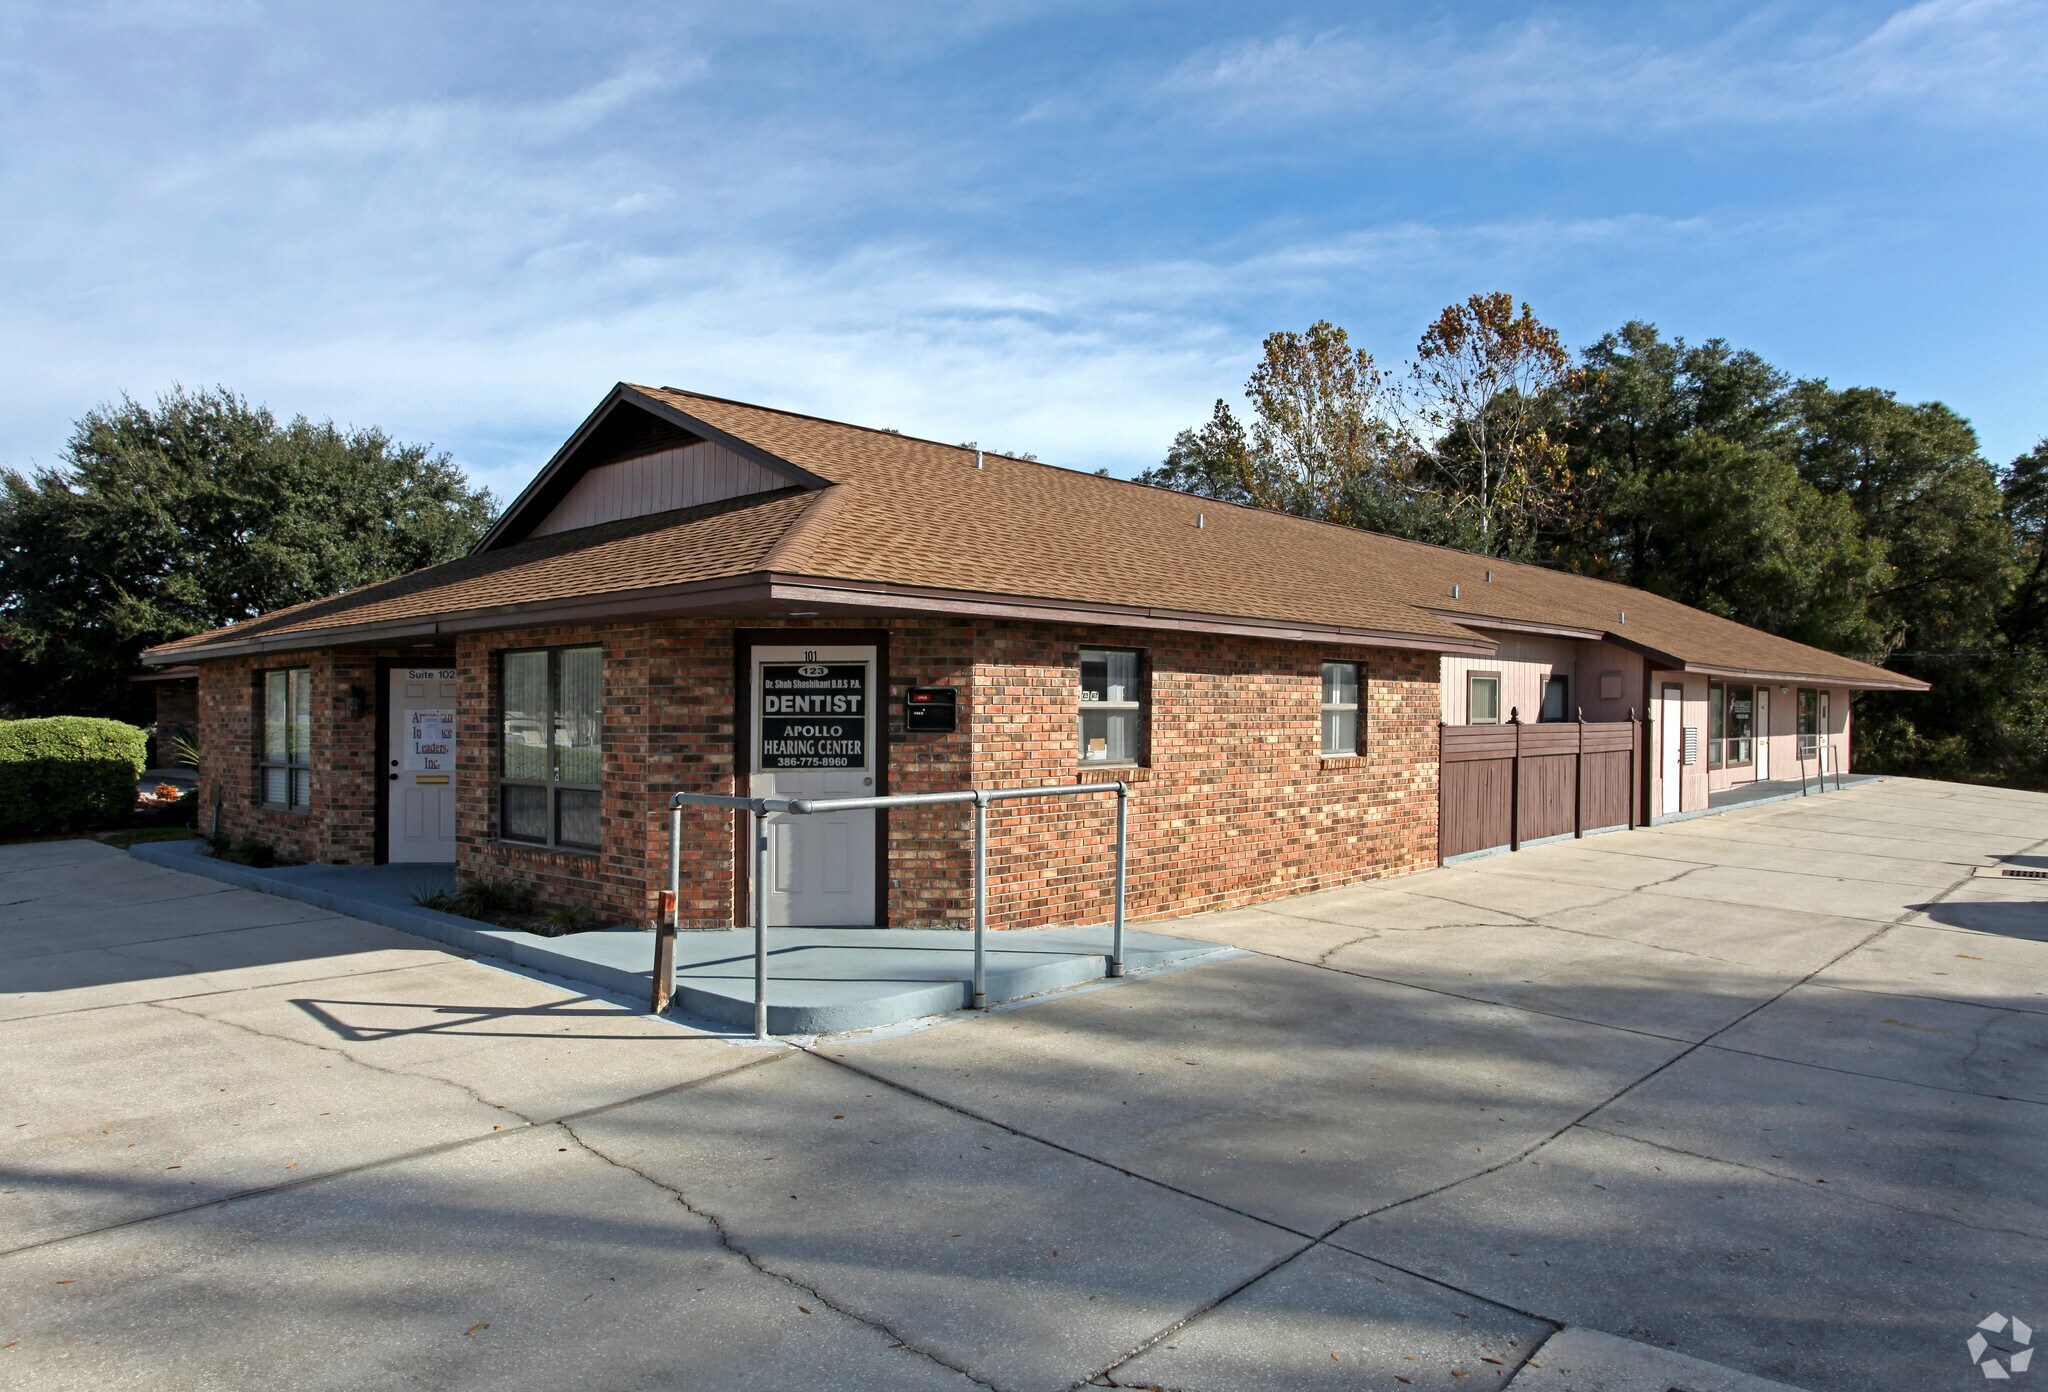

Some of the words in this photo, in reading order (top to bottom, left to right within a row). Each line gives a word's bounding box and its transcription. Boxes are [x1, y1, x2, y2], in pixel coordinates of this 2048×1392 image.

[804, 651, 817, 662] 101
[408, 670, 434, 679] Suite
[438, 670, 456, 679] 102
[802, 667, 824, 675] 123
[765, 680, 774, 689] Dr.
[775, 680, 792, 689] Shah
[793, 680, 831, 689] Shashikant
[765, 695, 861, 713] DENTIST
[783, 725, 843, 737] APOLLO
[415, 742, 449, 754] Leaders,
[764, 740, 815, 755] HEARING
[818, 740, 862, 755] CENTER
[424, 757, 440, 769] Inc.
[777, 757, 848, 767] 386-775-8960
